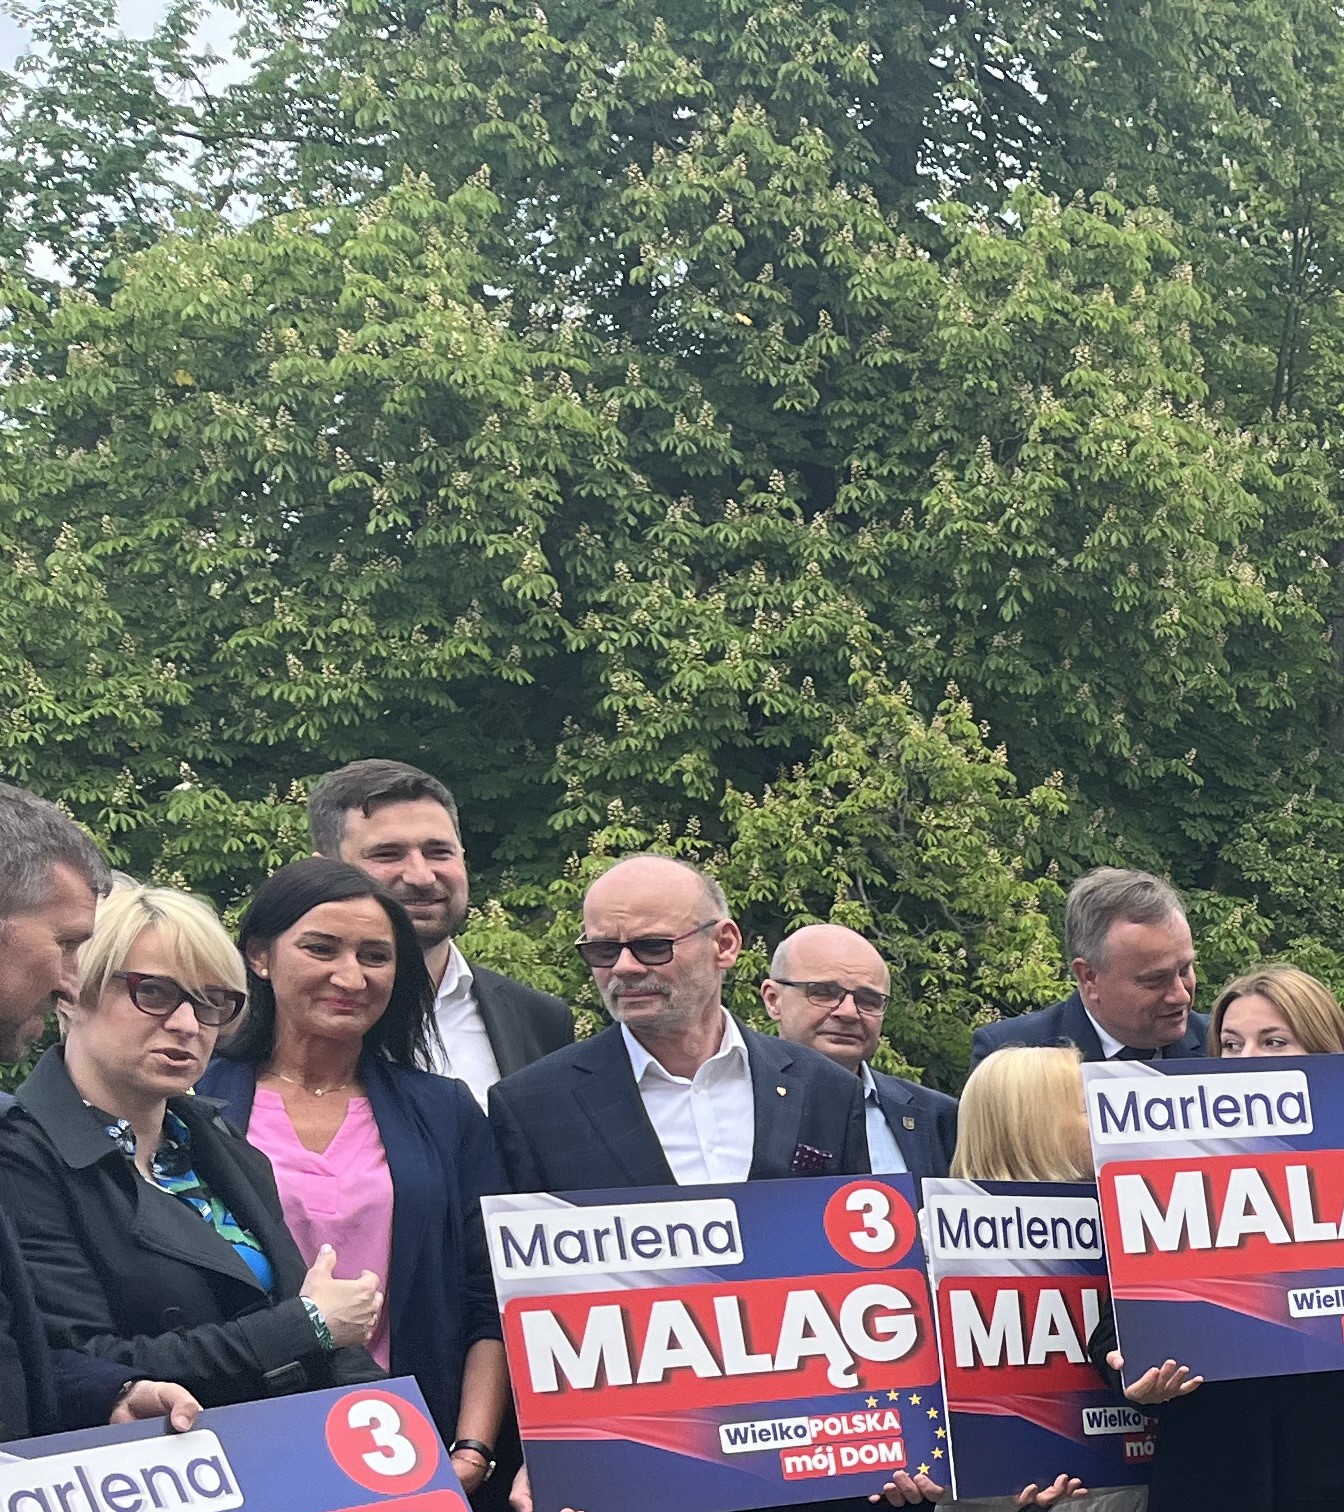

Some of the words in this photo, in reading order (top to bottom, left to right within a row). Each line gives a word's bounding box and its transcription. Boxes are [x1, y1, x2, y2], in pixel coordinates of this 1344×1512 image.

[1097, 1085, 1307, 1133] Marlena
[500, 1216, 737, 1268] Marlena
[845, 1188, 896, 1253] 3
[937, 1207, 1098, 1249] Marlena
[521, 1284, 917, 1393] MALĄG
[348, 1399, 416, 1477] 3
[726, 1412, 899, 1445] WielkoPOLSKA
[784, 1452, 836, 1476] mój
[841, 1442, 903, 1467] DOM
